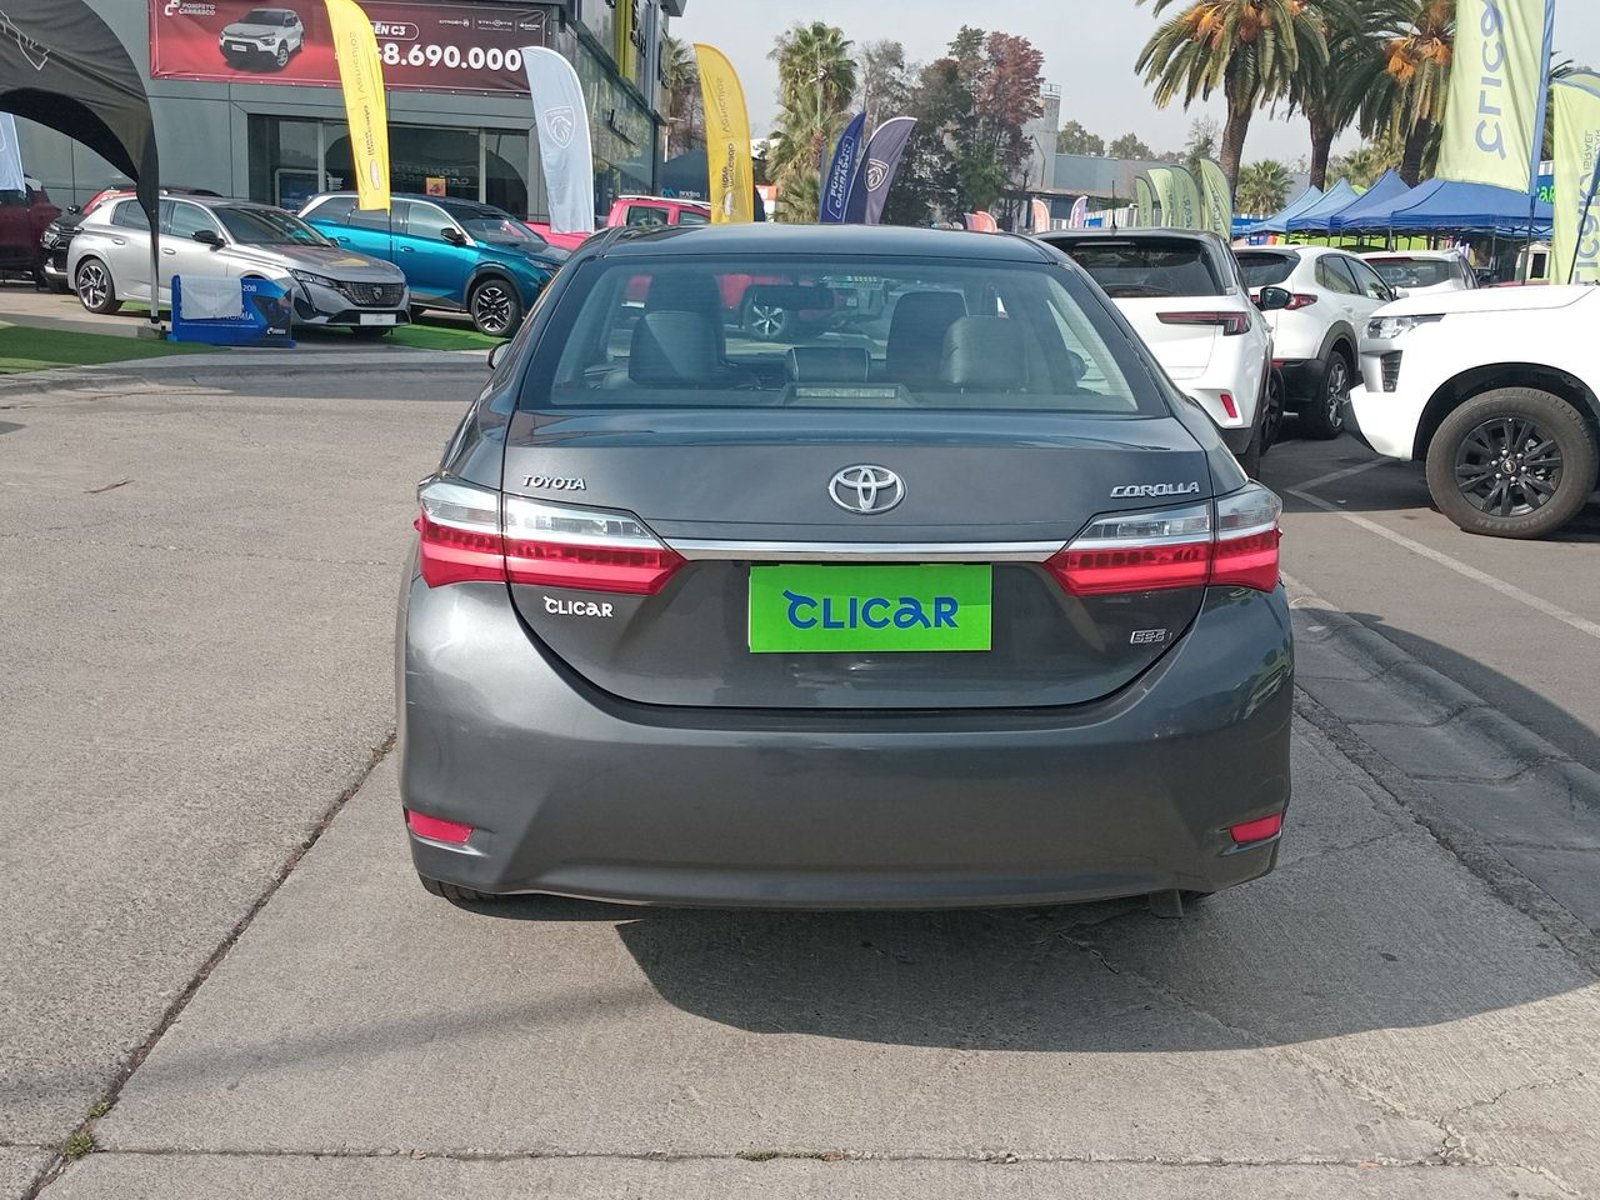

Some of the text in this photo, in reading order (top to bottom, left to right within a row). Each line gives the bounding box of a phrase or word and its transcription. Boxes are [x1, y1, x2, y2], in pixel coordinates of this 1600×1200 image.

[392, 26, 406, 36] C3
[242, 284, 257, 292] 208
[522, 474, 587, 491] TOYOTA
[1110, 481, 1200, 498] COROLLA
